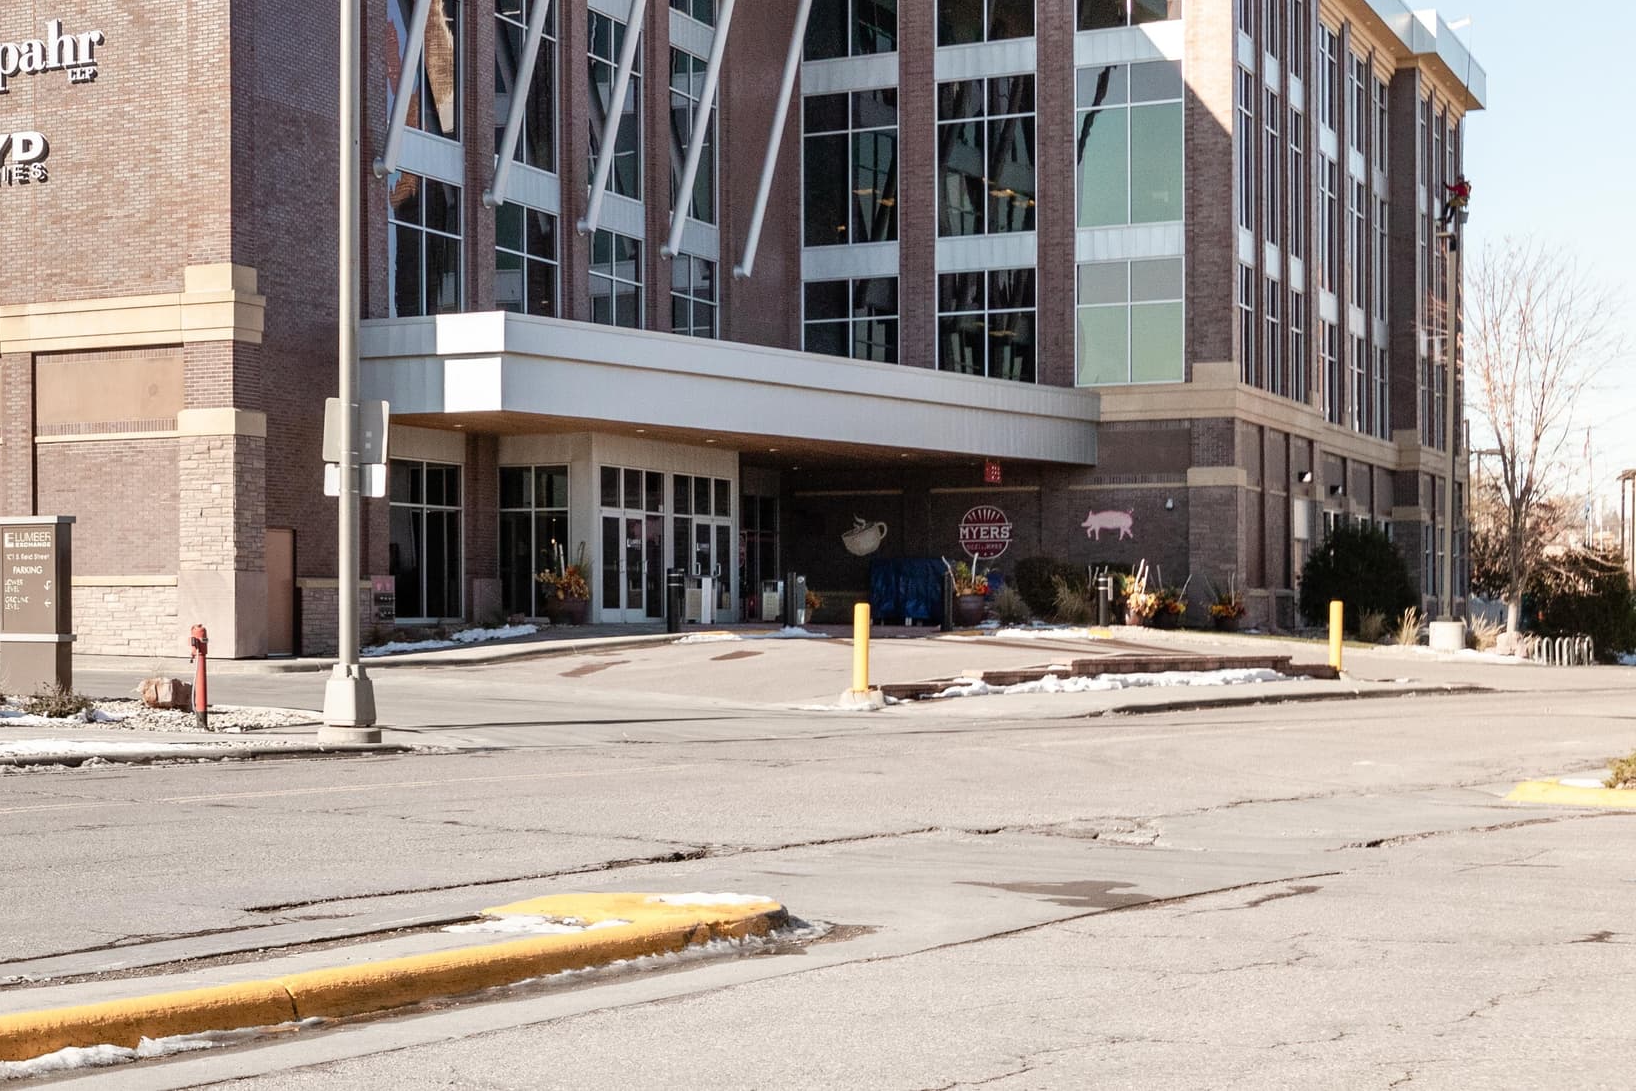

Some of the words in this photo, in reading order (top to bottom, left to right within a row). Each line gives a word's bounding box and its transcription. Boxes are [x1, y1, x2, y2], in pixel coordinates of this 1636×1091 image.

[67, 66, 99, 82] LLP
[14, 531, 52, 541] LUMBER
[12, 565, 44, 575] PARKING
